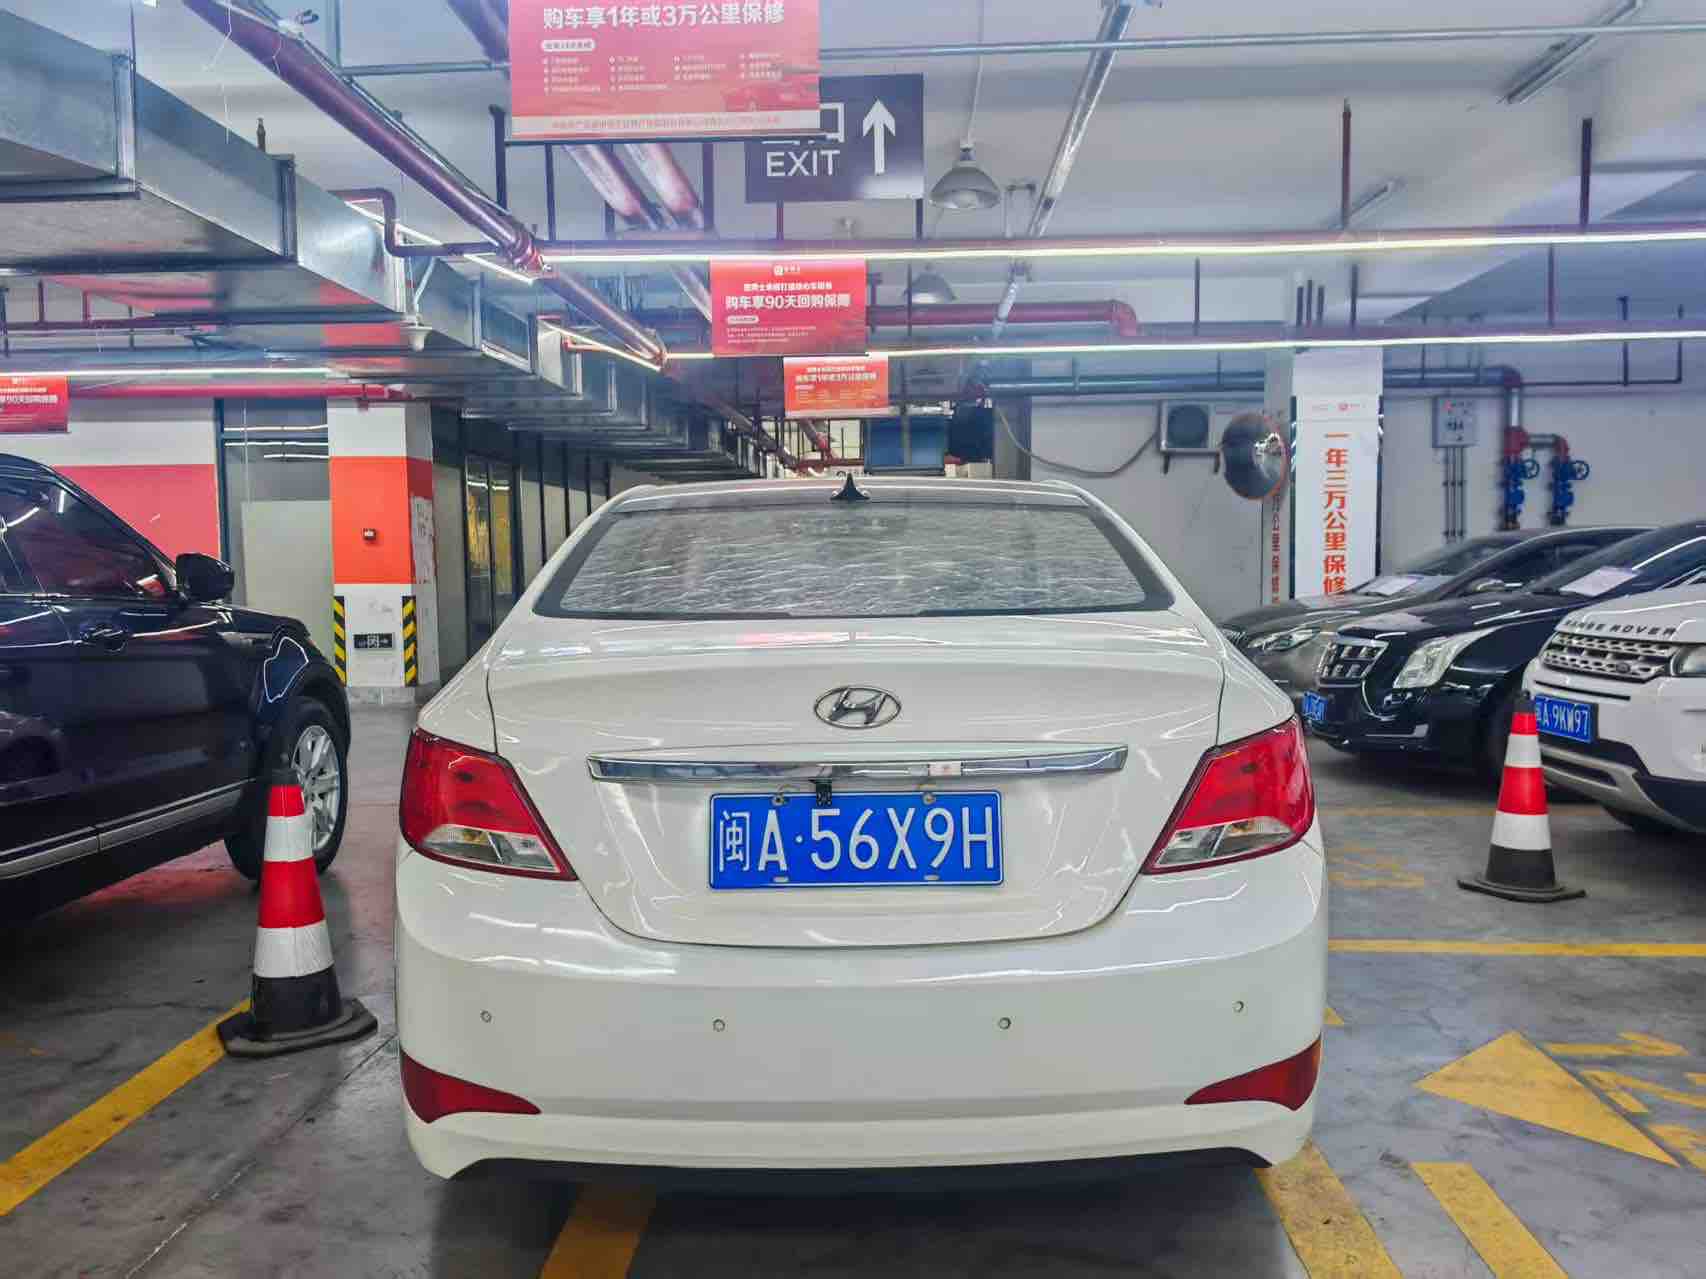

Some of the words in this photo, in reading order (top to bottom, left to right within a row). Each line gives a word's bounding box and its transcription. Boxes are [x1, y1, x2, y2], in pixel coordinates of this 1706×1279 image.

[543, 1, 785, 29] 购车享1年或3万公里保修
[766, 150, 841, 177] EXIT
[1323, 431, 1349, 597] 一年三万公里保修
[1609, 623, 1677, 636] ROVER
[719, 806, 994, 872] 闽A·56X9H
